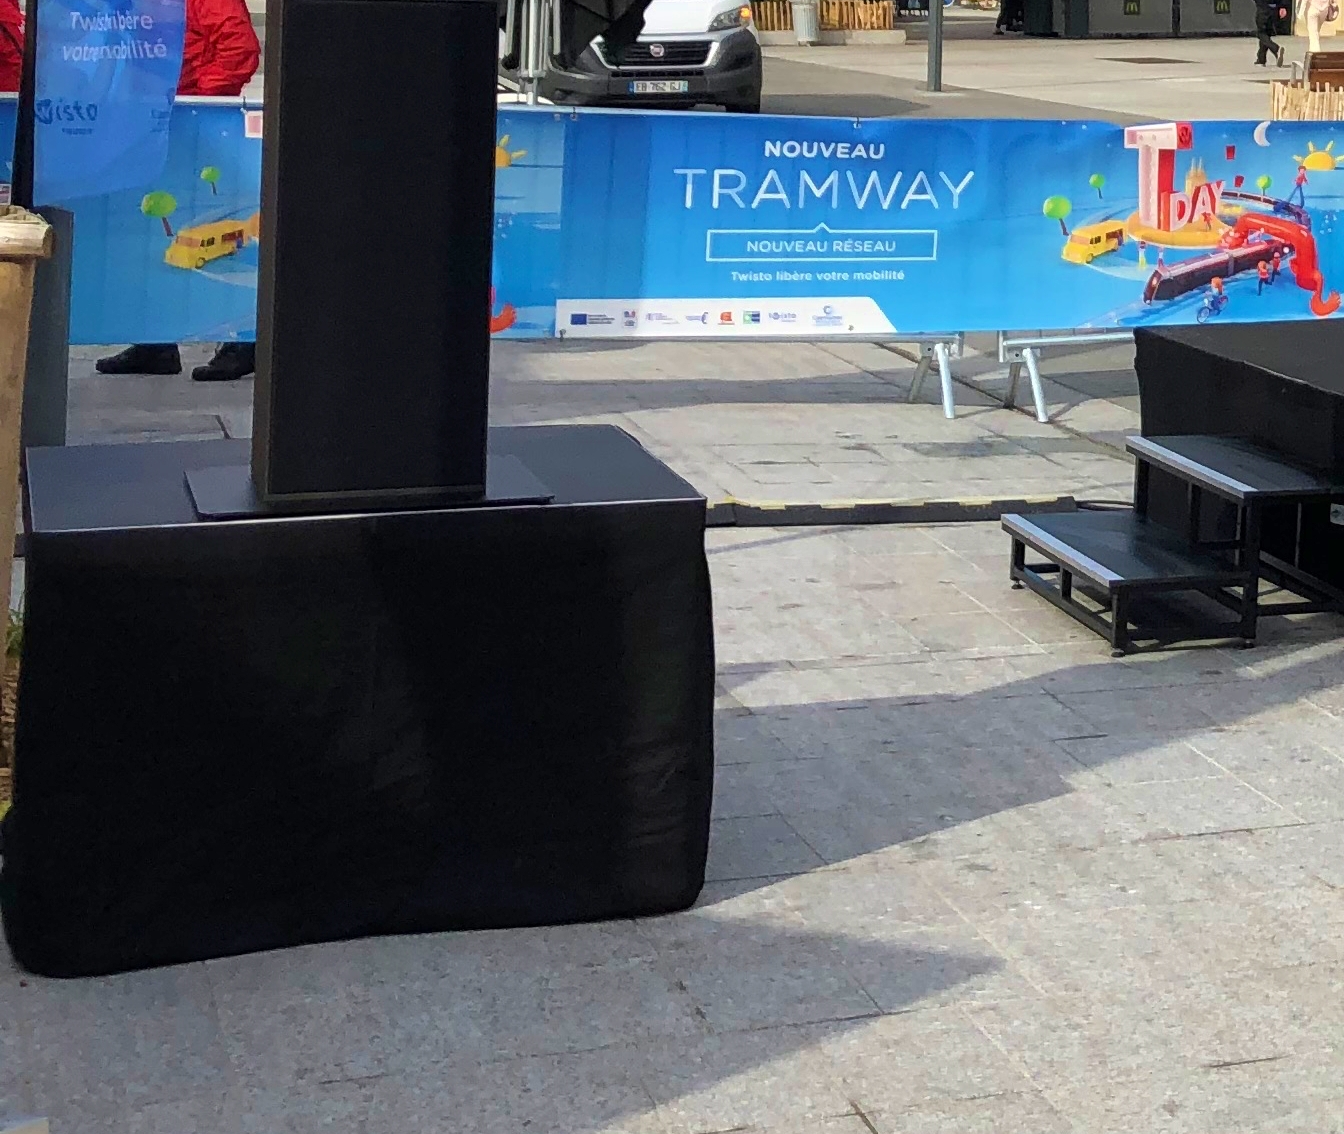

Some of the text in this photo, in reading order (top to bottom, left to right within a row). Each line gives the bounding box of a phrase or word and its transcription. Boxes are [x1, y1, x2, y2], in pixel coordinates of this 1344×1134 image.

[764, 140, 886, 159] NOUVEAU
[1123, 122, 1227, 232] T DAY
[673, 168, 975, 209] TRAMWAY
[746, 238, 897, 253] NOUVEAU RÉSEAU
[731, 270, 905, 282] Twisto libère votre mobilité
